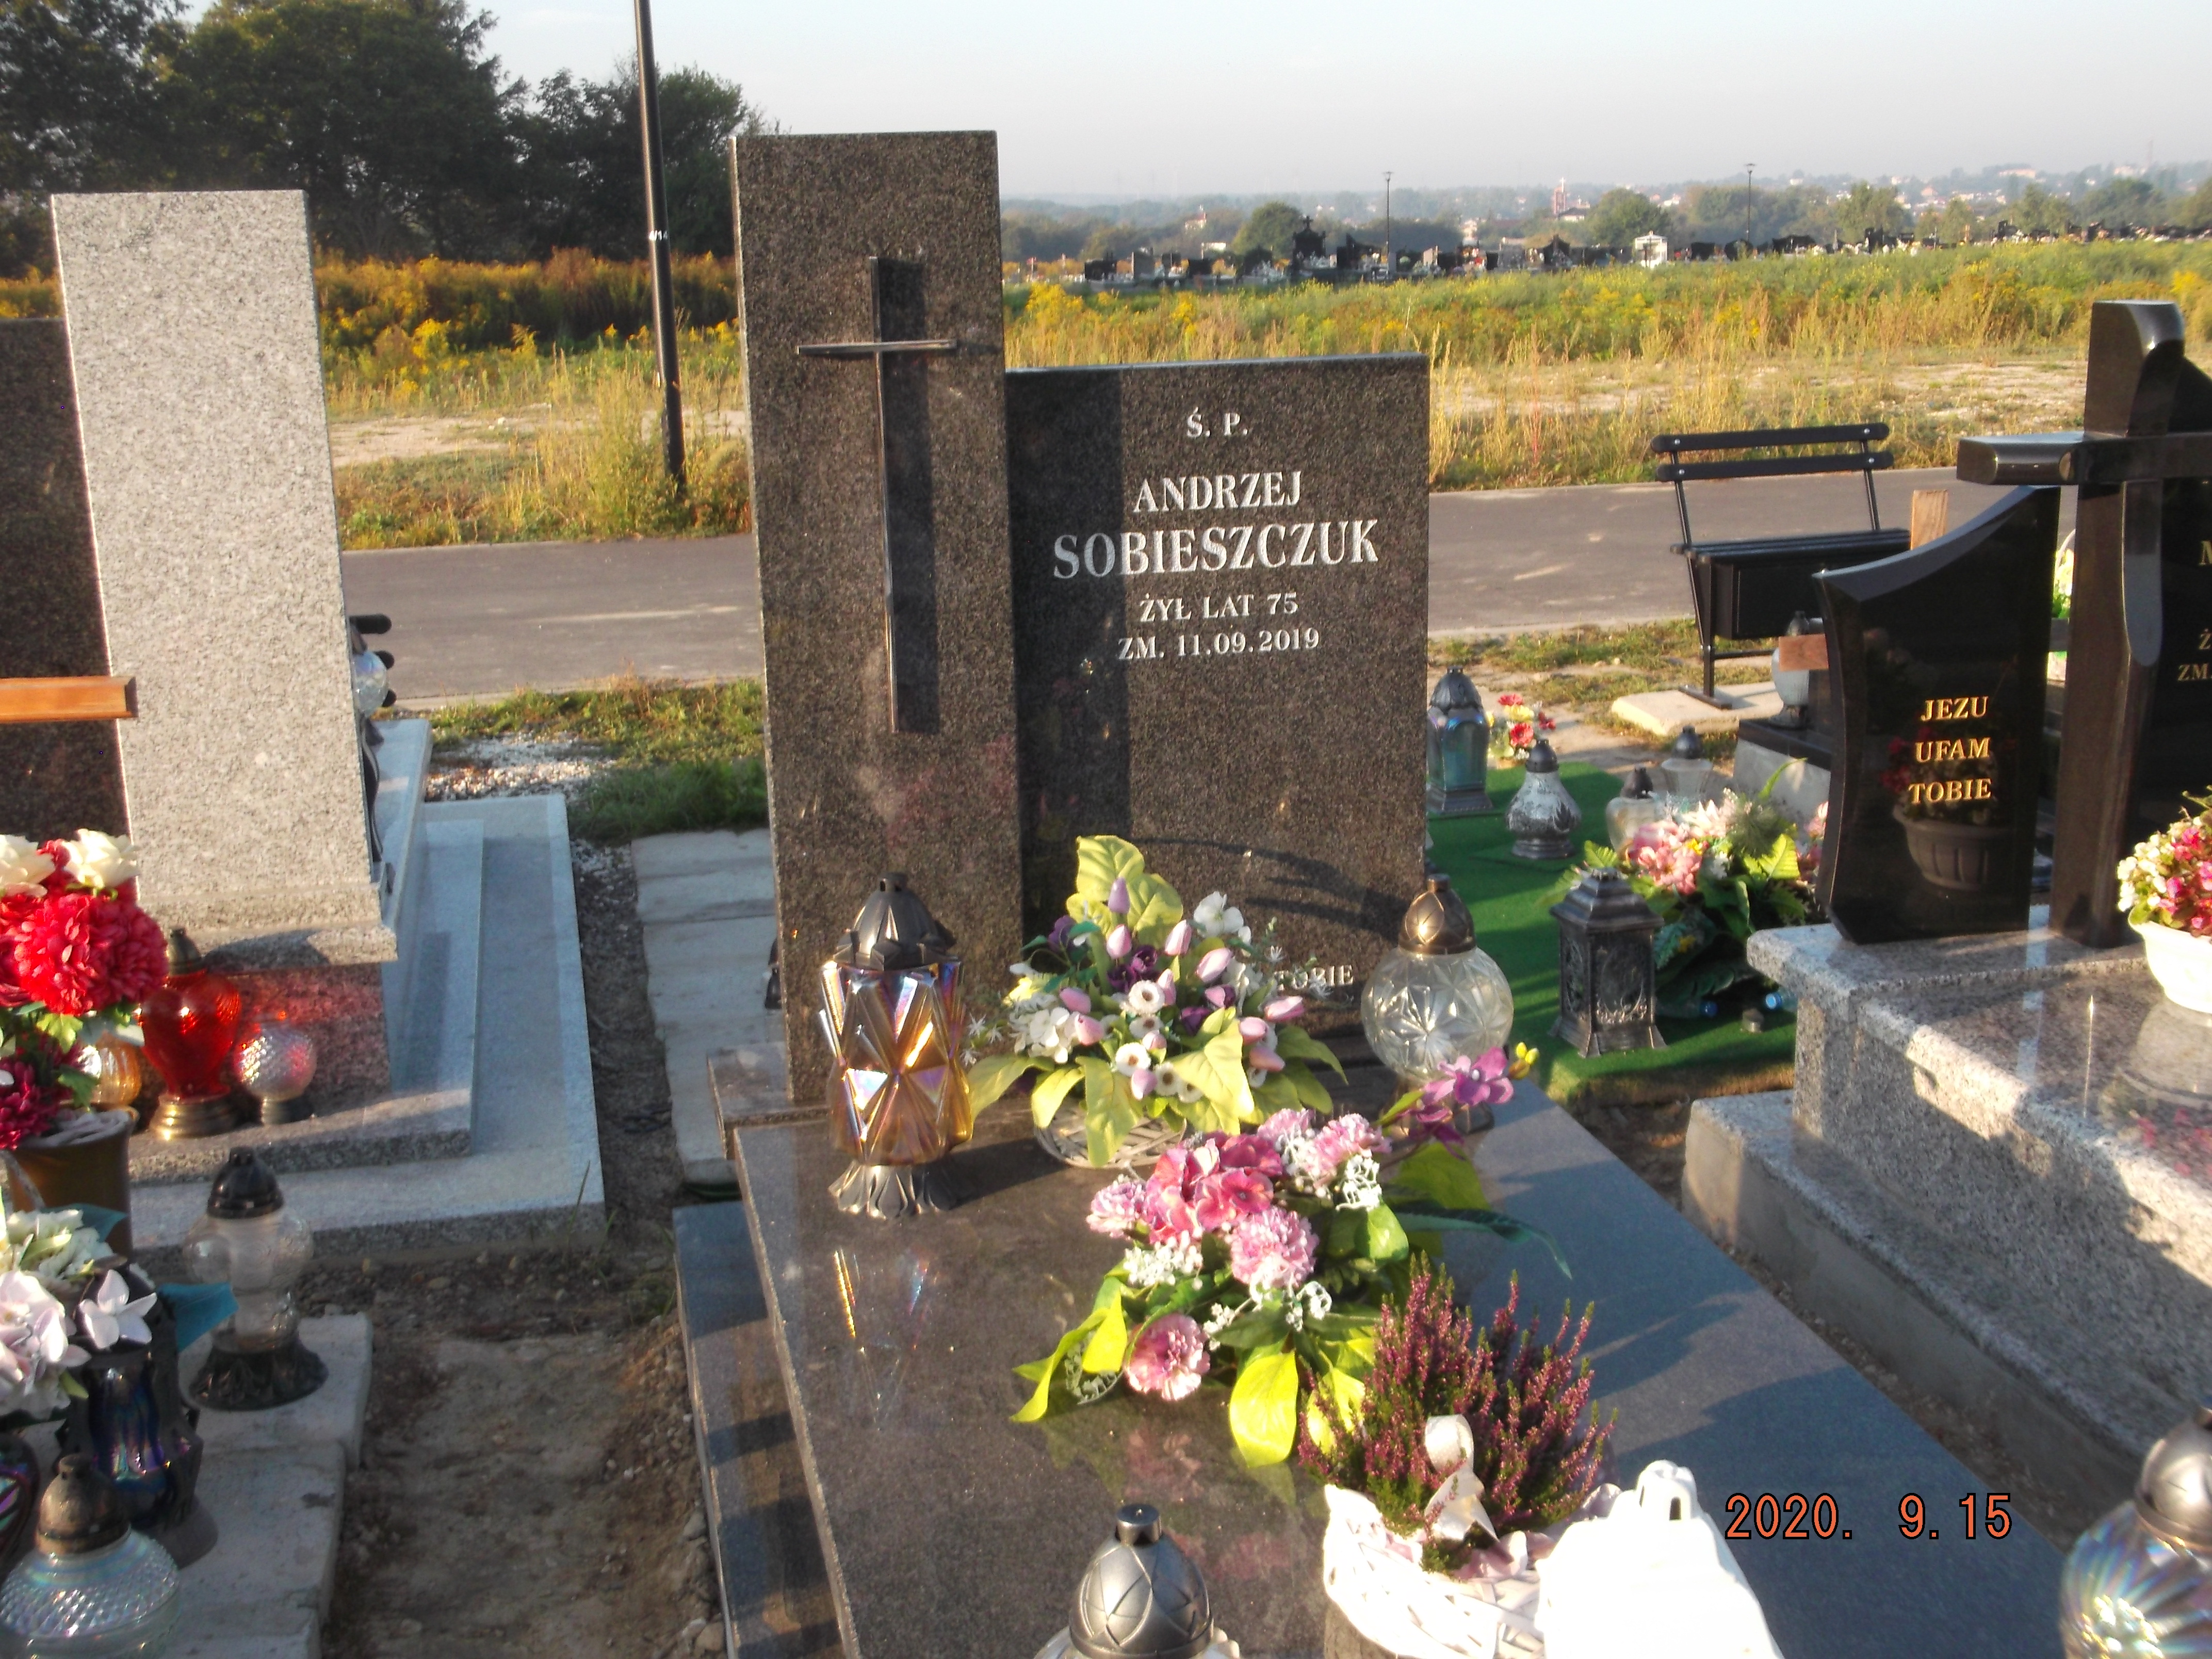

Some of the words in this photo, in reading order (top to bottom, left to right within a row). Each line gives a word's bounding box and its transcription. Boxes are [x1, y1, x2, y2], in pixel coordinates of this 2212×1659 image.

[1185, 407, 1211, 438] Ś.
[1223, 412, 1248, 436] P.
[1132, 470, 1303, 513] ANDRZEJ
[1053, 518, 1380, 579] SOBIESZCZUK
[1139, 593, 1192, 623] ŻYŁ
[1203, 594, 1254, 620] LAT
[1267, 592, 1299, 615] 75
[1118, 637, 1165, 661] ZM.
[1177, 627, 1321, 657] 11.09.2019
[1920, 695, 1990, 722] JEZU
[1914, 737, 1991, 763] UFAM
[1908, 778, 1993, 805] TOBIE
